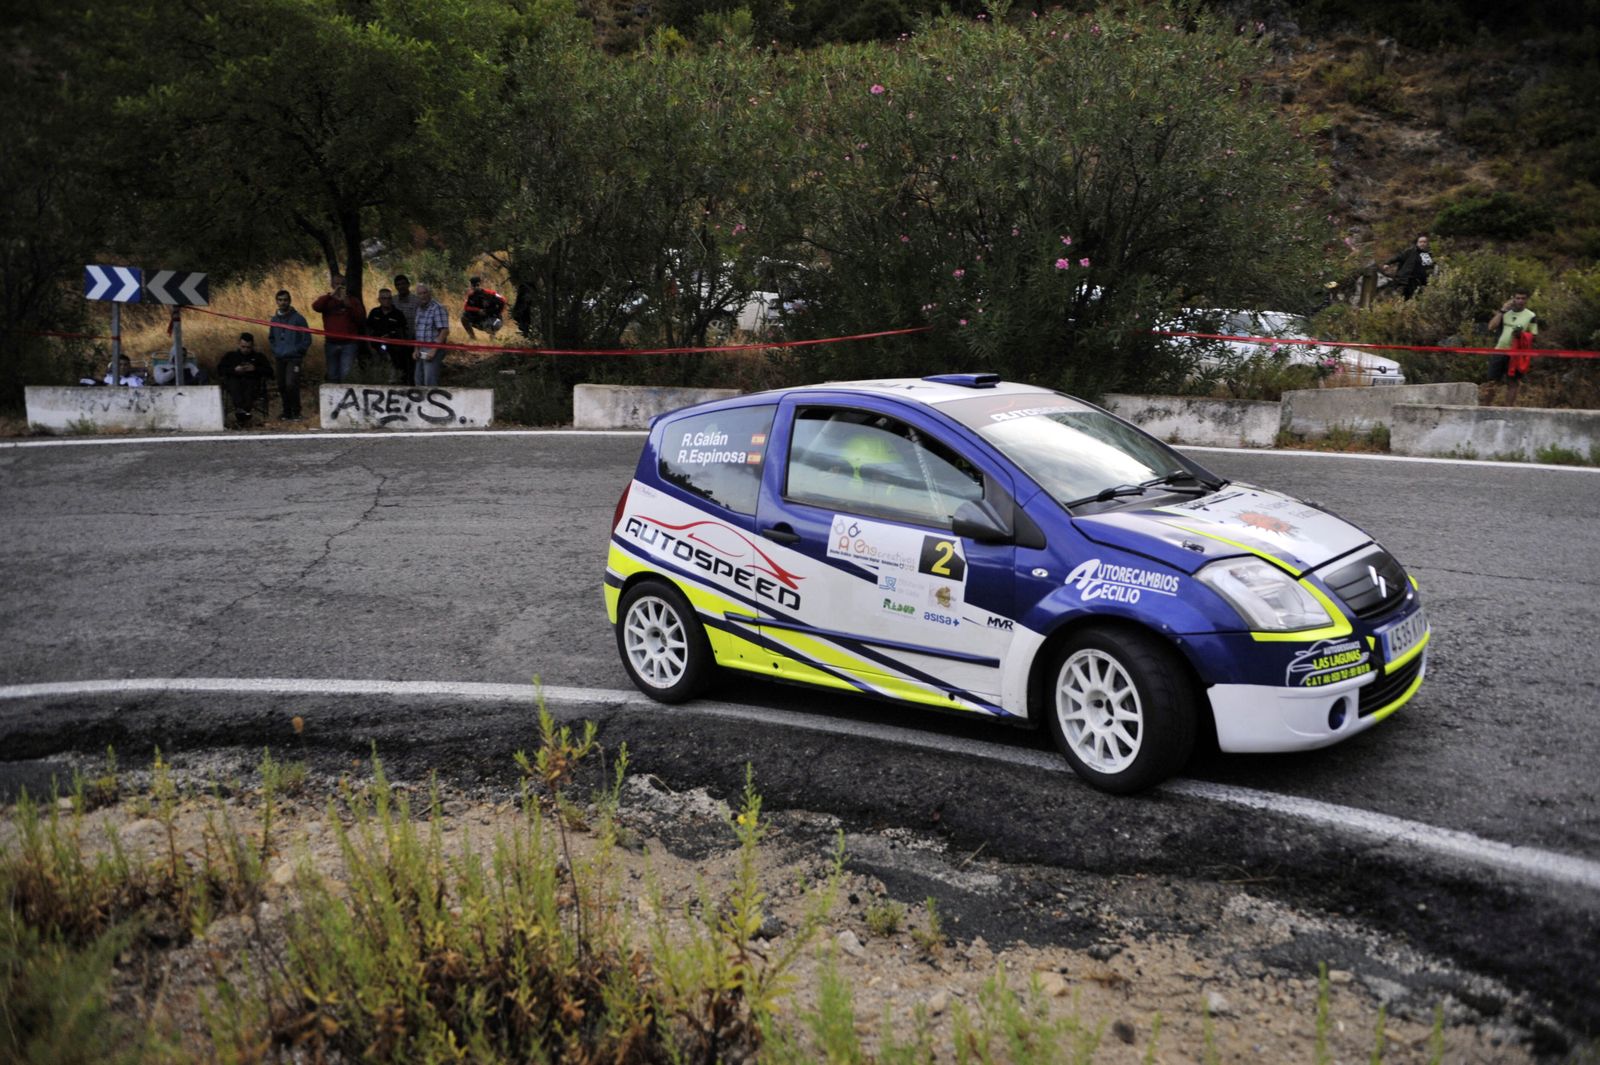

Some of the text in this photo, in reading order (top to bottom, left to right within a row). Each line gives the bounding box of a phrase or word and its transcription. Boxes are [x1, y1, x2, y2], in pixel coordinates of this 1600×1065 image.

[681, 431, 729, 447] R.Galán
[677, 448, 747, 467] R.Espinosa
[625, 517, 801, 611] AUTOSPEED
[931, 541, 955, 576] 2
[1064, 558, 1180, 592] AUTORECAMBIOS
[1080, 580, 1141, 604] CECILIO
[987, 616, 1014, 631] MVR
[1313, 657, 1329, 670] LAS
